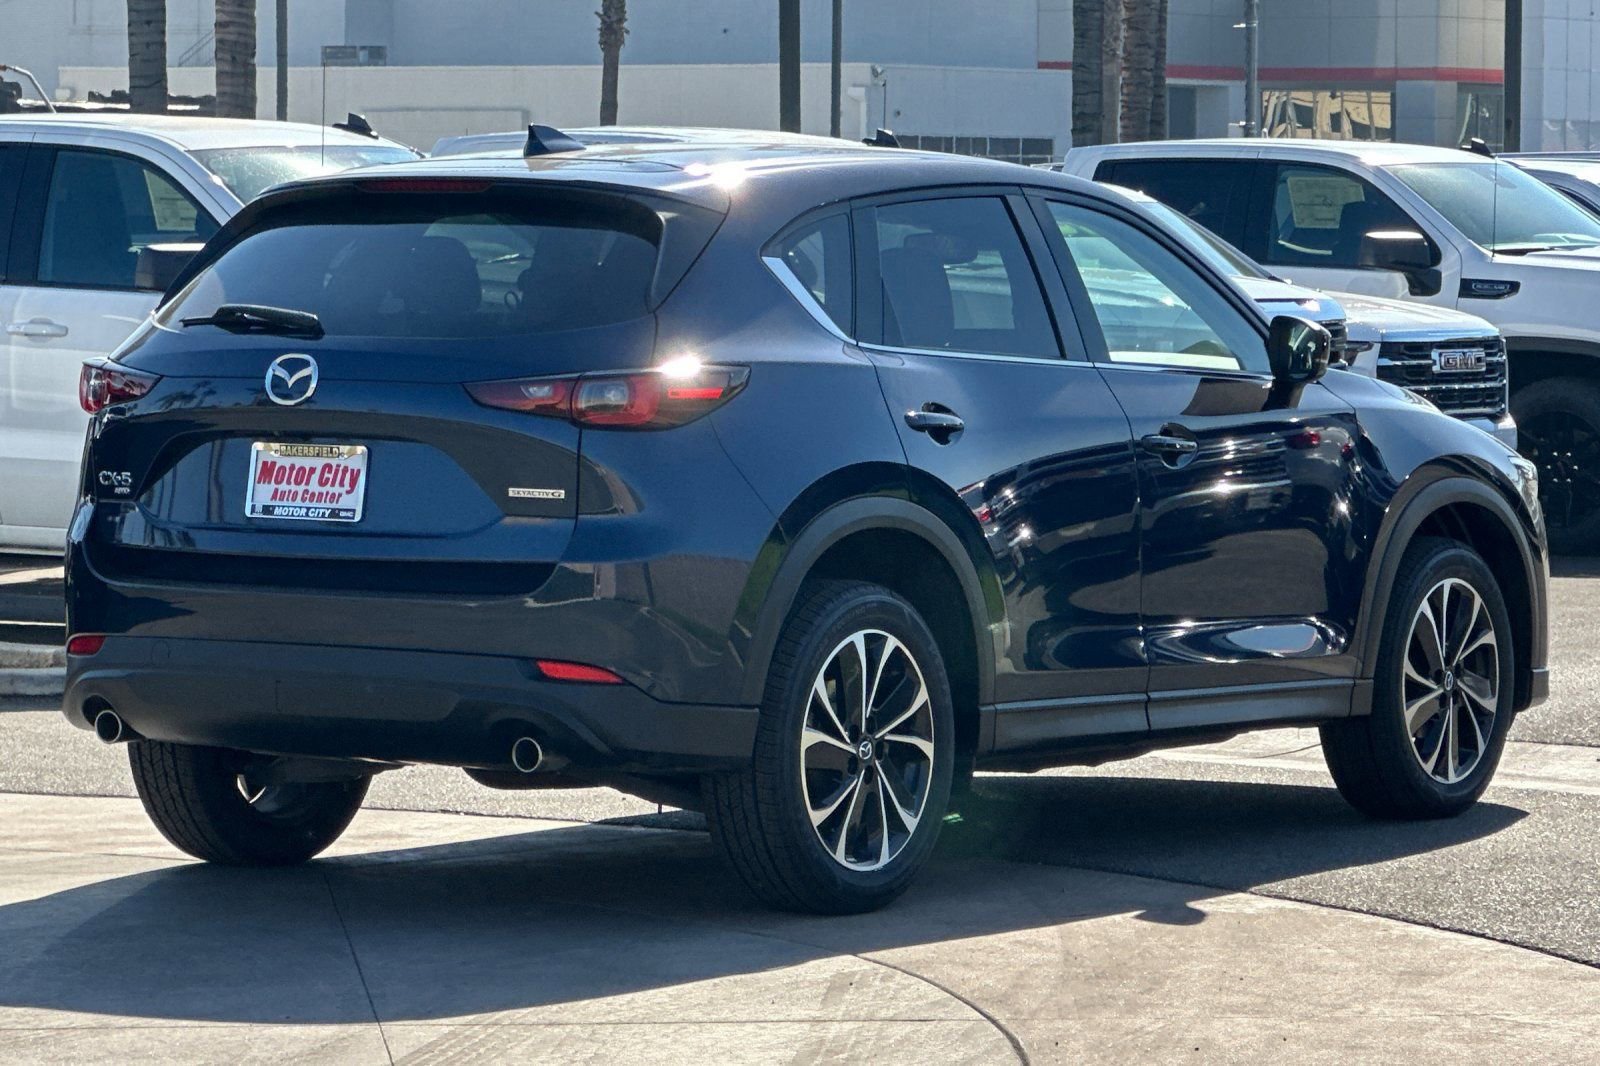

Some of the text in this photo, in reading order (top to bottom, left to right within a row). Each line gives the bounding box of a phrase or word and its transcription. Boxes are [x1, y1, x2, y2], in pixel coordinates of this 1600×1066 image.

[1440, 351, 1486, 370] GMC
[280, 445, 339, 457] BAKERSFIELD
[99, 470, 131, 486] CX-5
[257, 460, 361, 494] Motor City
[270, 487, 343, 504] Auto Center
[273, 506, 307, 517] MOTOR
[307, 508, 332, 518] CITY
